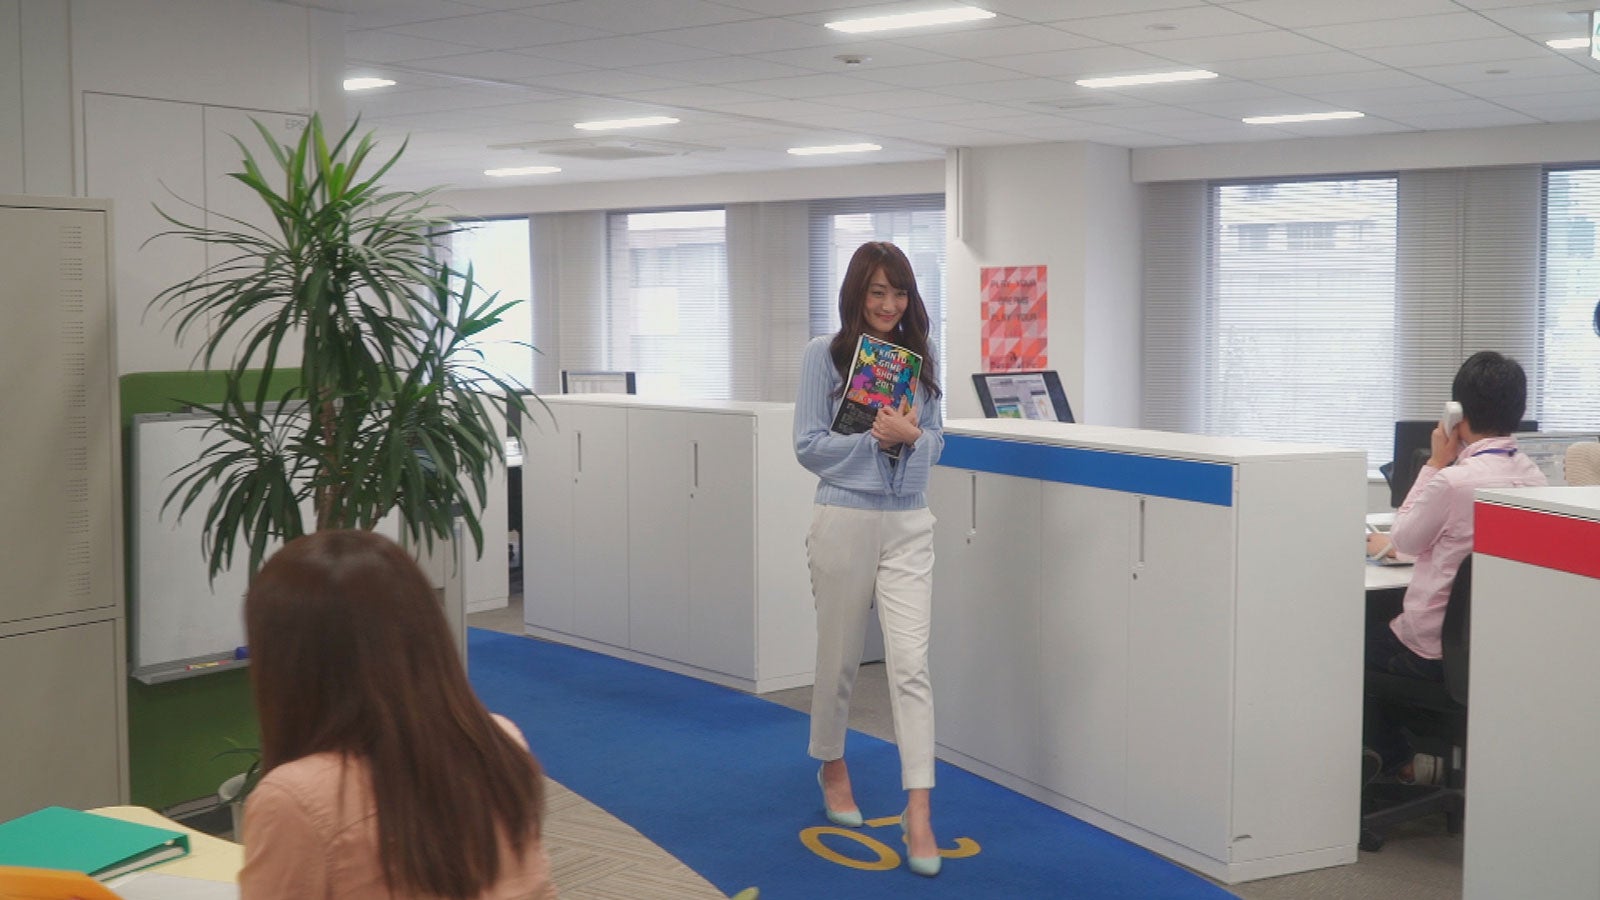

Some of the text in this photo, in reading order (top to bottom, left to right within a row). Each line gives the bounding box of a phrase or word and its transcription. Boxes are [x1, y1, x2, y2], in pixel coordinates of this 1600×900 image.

[878, 349, 907, 363] KANTO
[878, 360, 901, 372] GAME
[876, 368, 900, 382] SHOW
